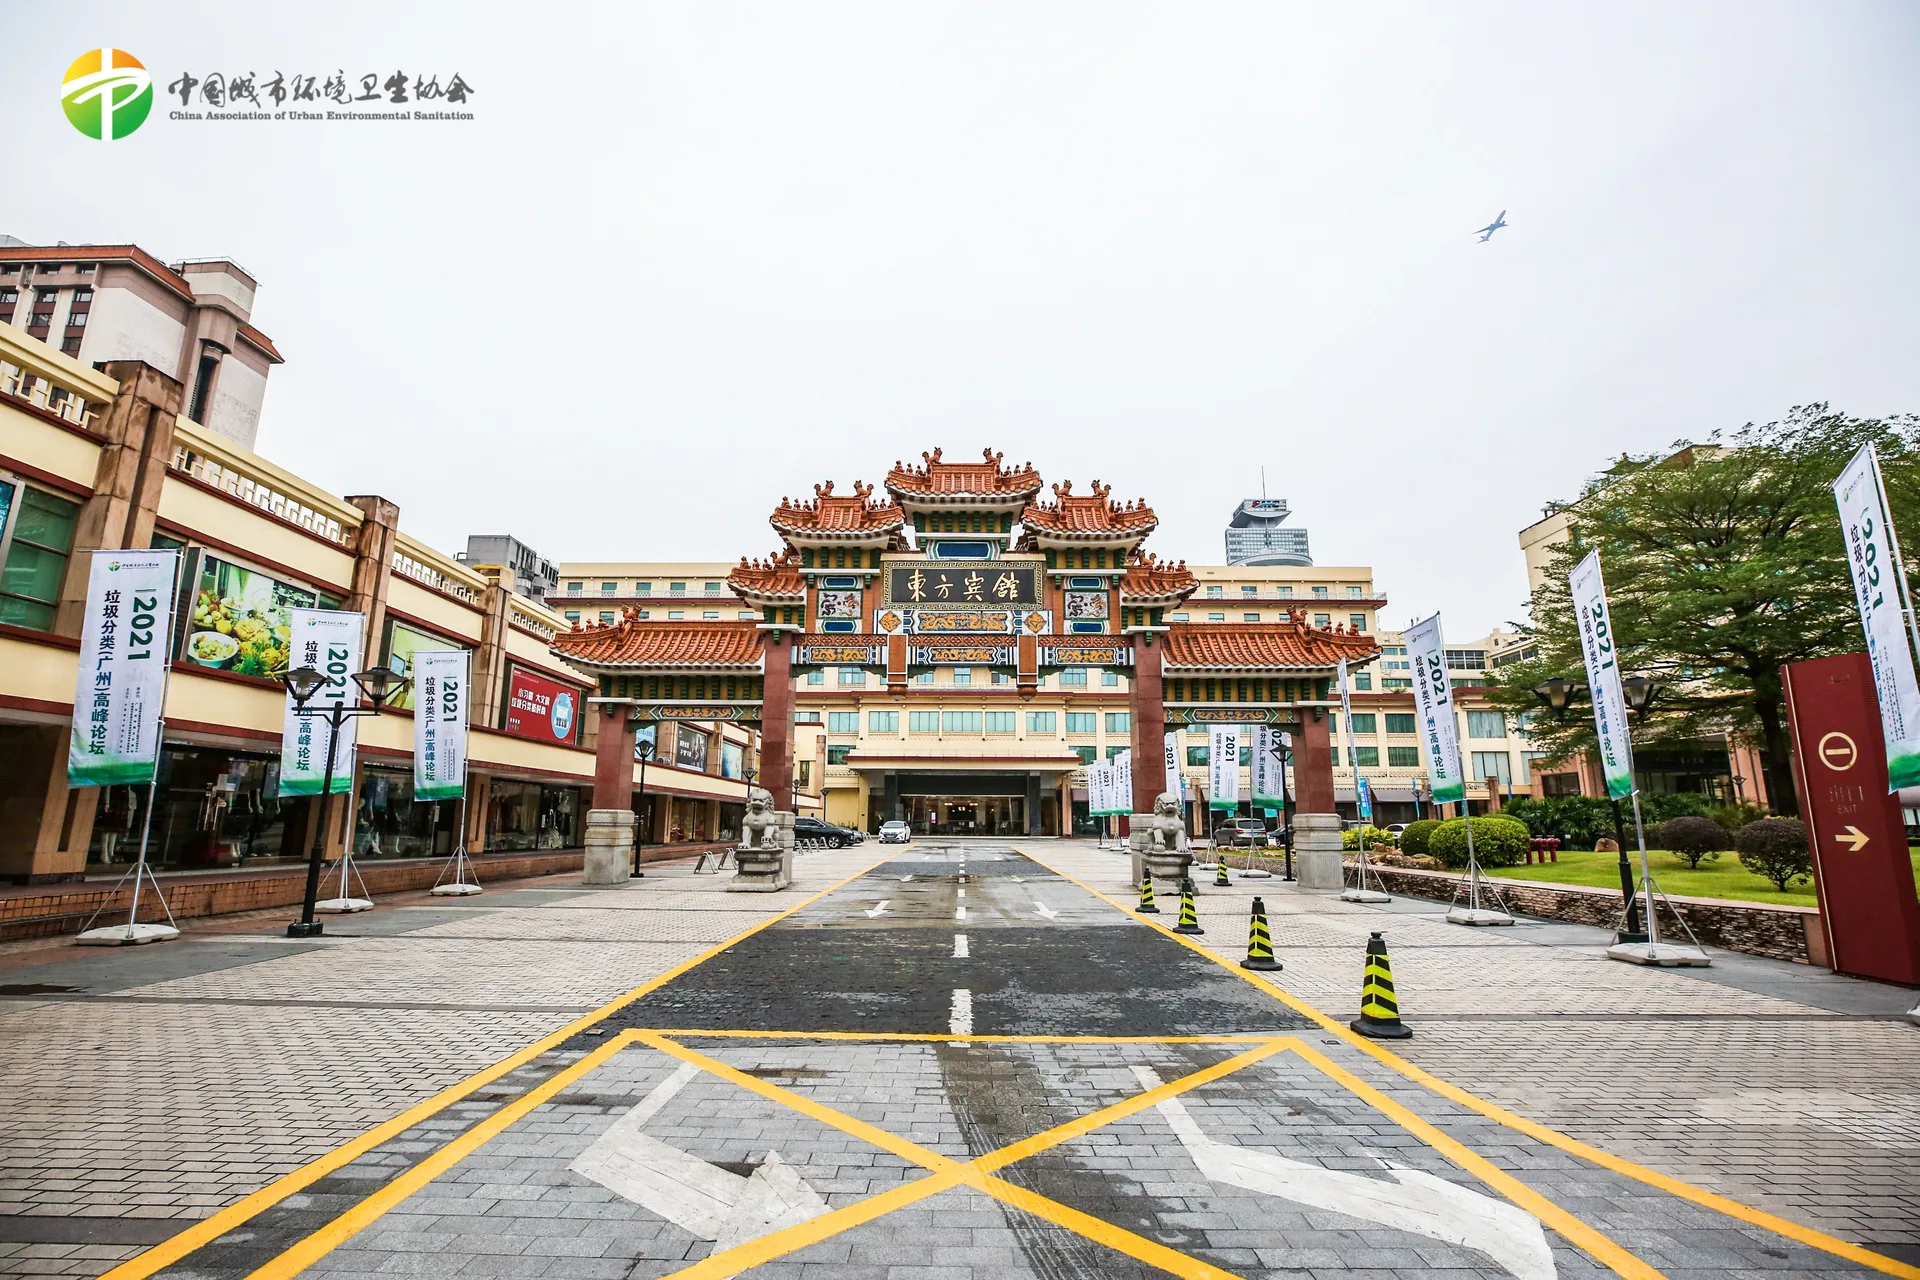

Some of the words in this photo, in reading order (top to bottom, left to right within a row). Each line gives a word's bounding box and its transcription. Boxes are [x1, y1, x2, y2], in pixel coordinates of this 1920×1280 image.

[1861, 518, 1884, 610] 2021
[127, 596, 157, 661] 2021
[1590, 603, 1614, 670] 2021
[88, 590, 122, 755] 垃圾分类(广州)高峰论坛
[325, 648, 349, 699] 2021
[1427, 655, 1448, 706] 2021
[443, 682, 458, 722] 2021
[1166, 747, 1175, 770] 2021
[1225, 736, 1235, 762] 2021
[1258, 725, 1267, 794] 圾分类(广州)高峰论坛
